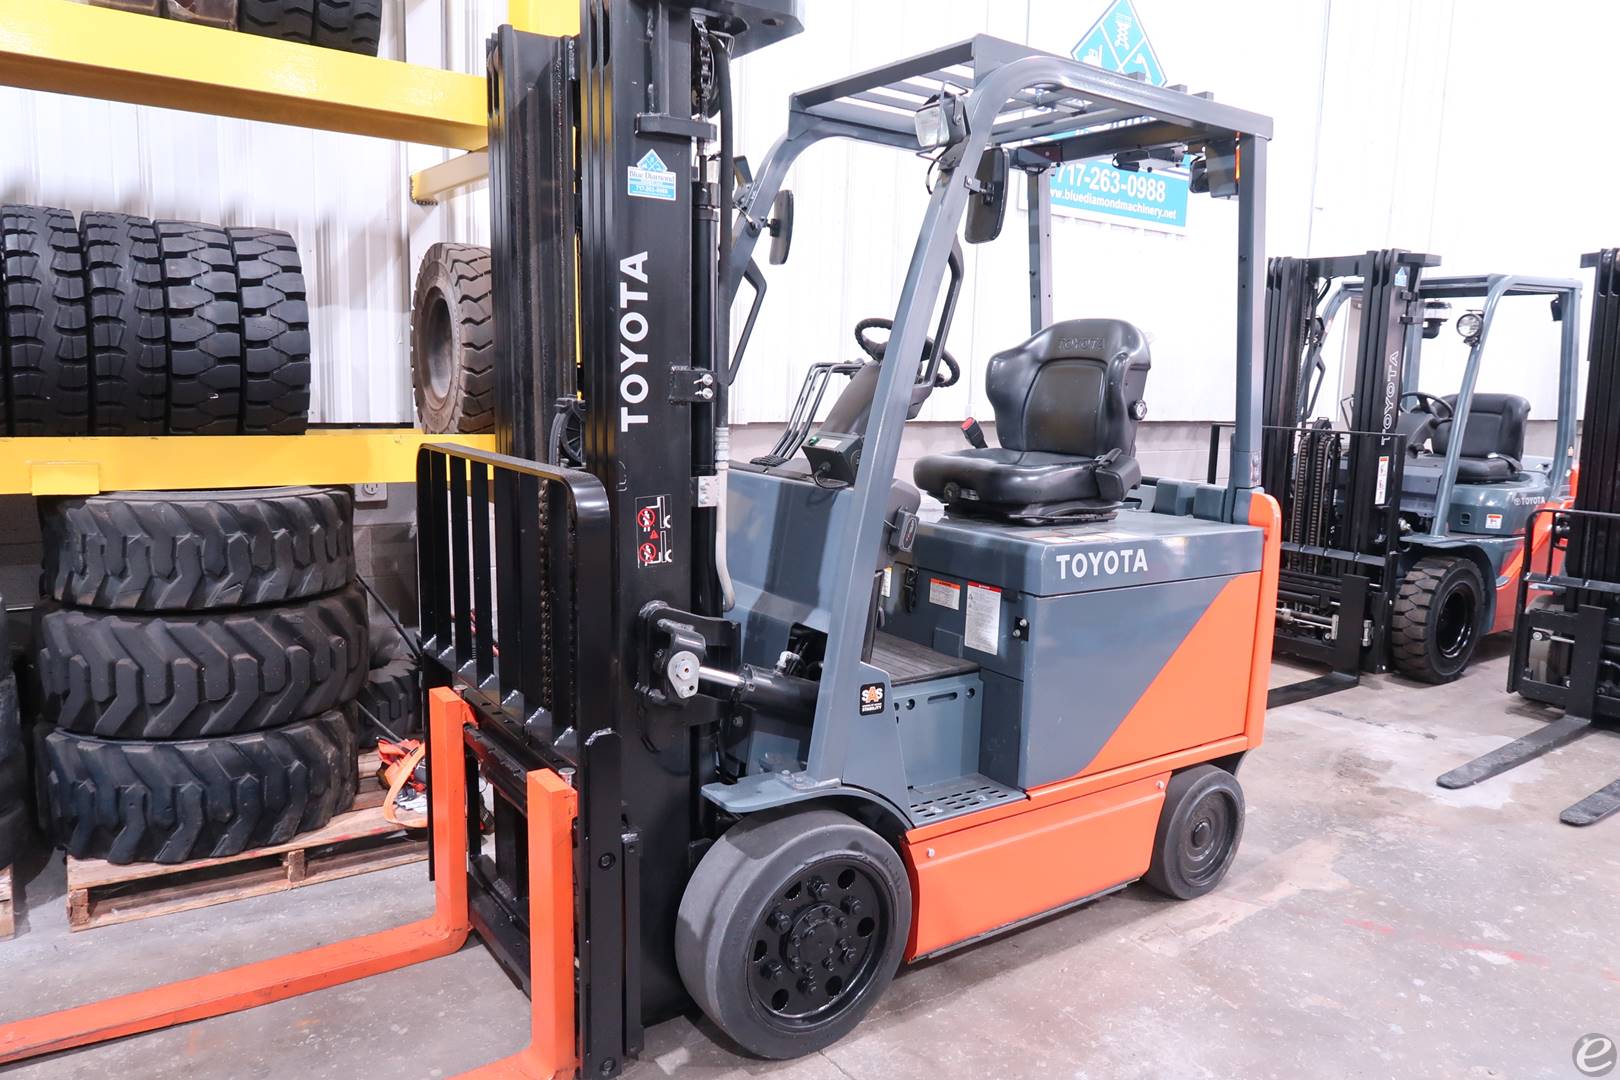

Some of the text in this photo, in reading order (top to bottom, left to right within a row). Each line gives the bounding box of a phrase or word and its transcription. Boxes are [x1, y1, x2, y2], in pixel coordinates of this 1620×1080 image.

[1057, 163, 1166, 203] 717-263-0988
[619, 251, 649, 433] TOYOTA
[1057, 336, 1105, 351] TOYOTA
[1381, 351, 1399, 446] TOYOTA
[1521, 496, 1546, 505] TOYOTA
[1056, 548, 1149, 580] TOYOTA
[861, 686, 883, 703] SAS
